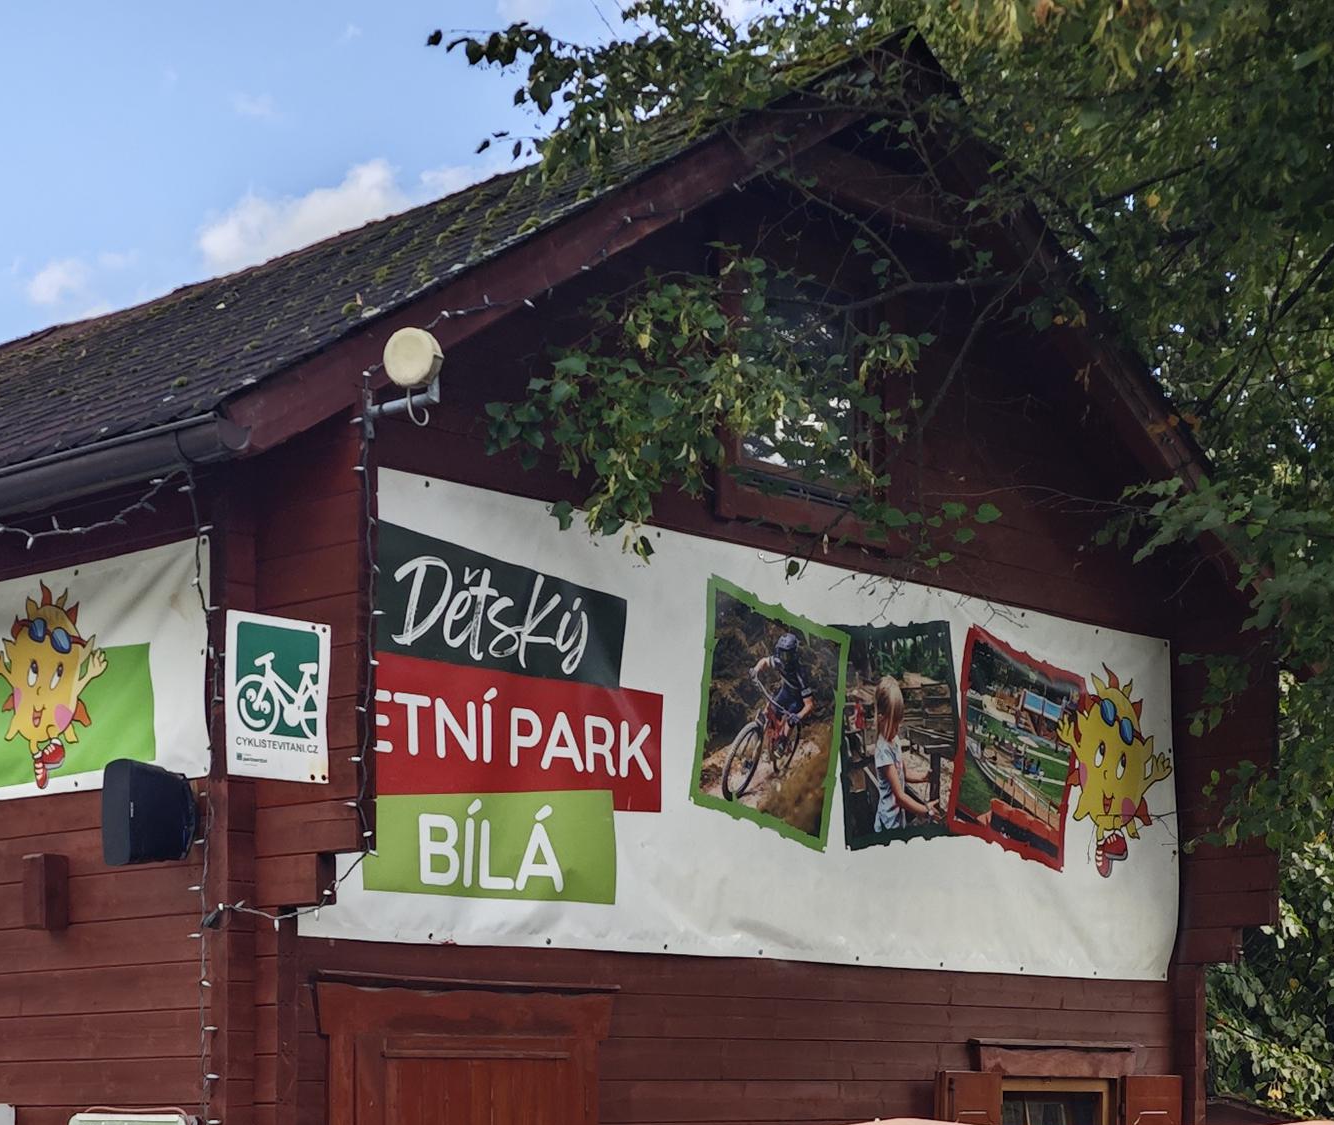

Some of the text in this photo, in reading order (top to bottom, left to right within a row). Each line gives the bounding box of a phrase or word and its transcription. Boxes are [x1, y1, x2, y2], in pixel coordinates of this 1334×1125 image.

[391, 556, 588, 675] Dětský
[235, 736, 319, 754] CYKLISTEVITANI.CZ
[373, 687, 654, 780] ETNÍ PARK
[419, 798, 564, 893] BÍLÁ
